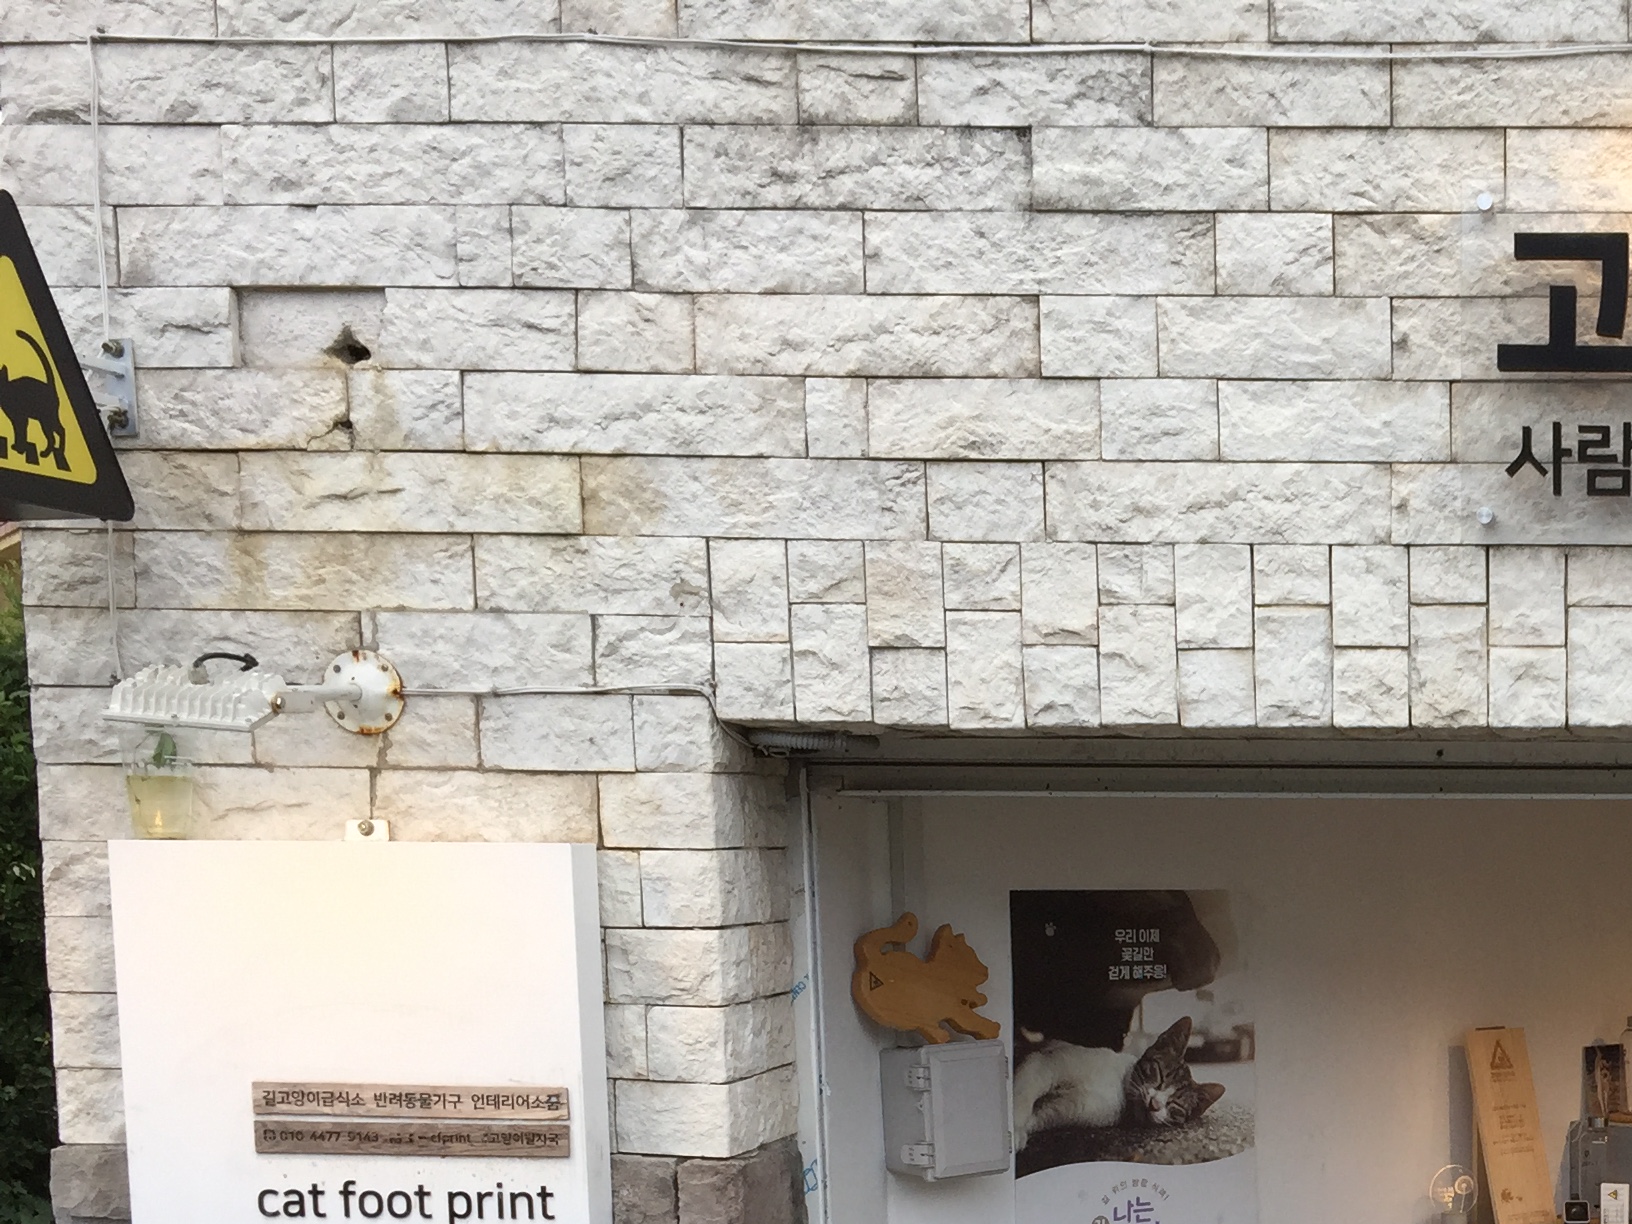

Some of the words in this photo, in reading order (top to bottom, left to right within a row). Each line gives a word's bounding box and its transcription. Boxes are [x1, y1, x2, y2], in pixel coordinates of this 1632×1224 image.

[1114, 928, 1137, 944] 우리
[1139, 928, 1160, 943] 이제
[1121, 946, 1155, 962] 꽃길만
[1108, 965, 1131, 981] 걷게
[262, 1089, 366, 1108] 길고양이급식소
[470, 1092, 562, 1112] 인테리어소품
[309, 1130, 341, 1142] 4477
[257, 1182, 327, 1219] cat
[339, 1180, 433, 1220] foot
[1112, 1196, 1155, 1224] 나는
